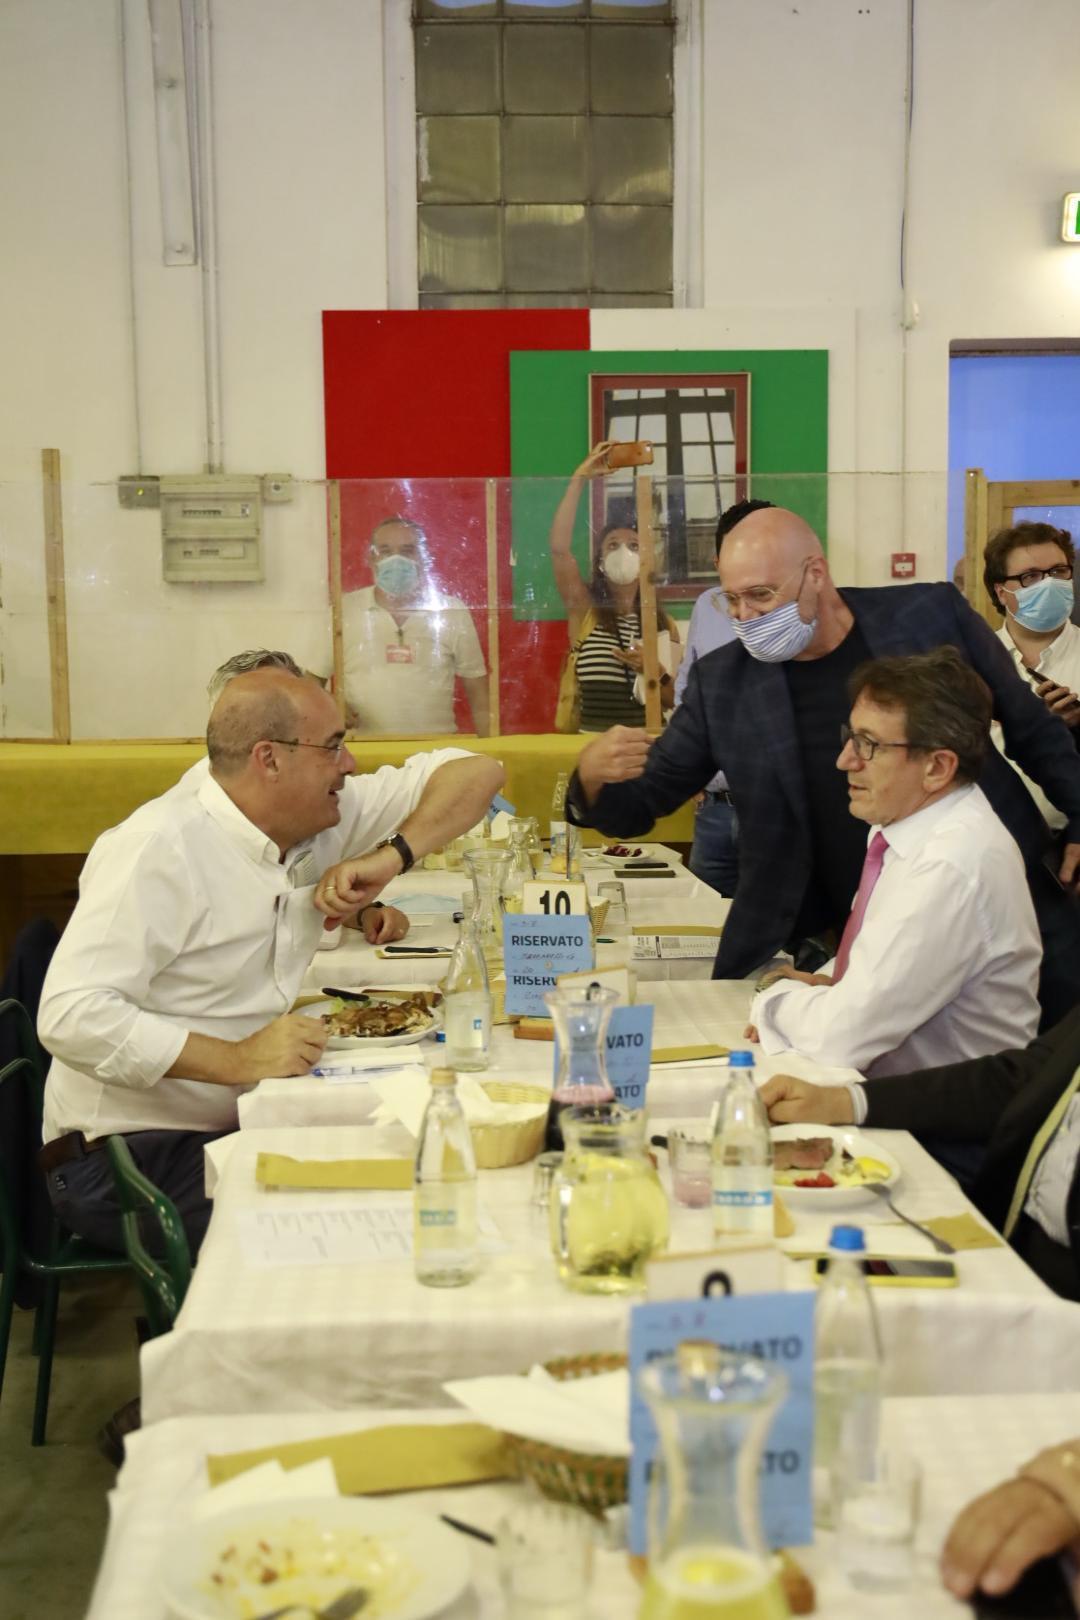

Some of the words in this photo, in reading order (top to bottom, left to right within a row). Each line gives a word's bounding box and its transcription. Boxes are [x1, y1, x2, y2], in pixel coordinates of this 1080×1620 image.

[540, 890, 571, 915] 10
[511, 935, 584, 947] RISERVATO
[513, 975, 557, 986] RISERV
